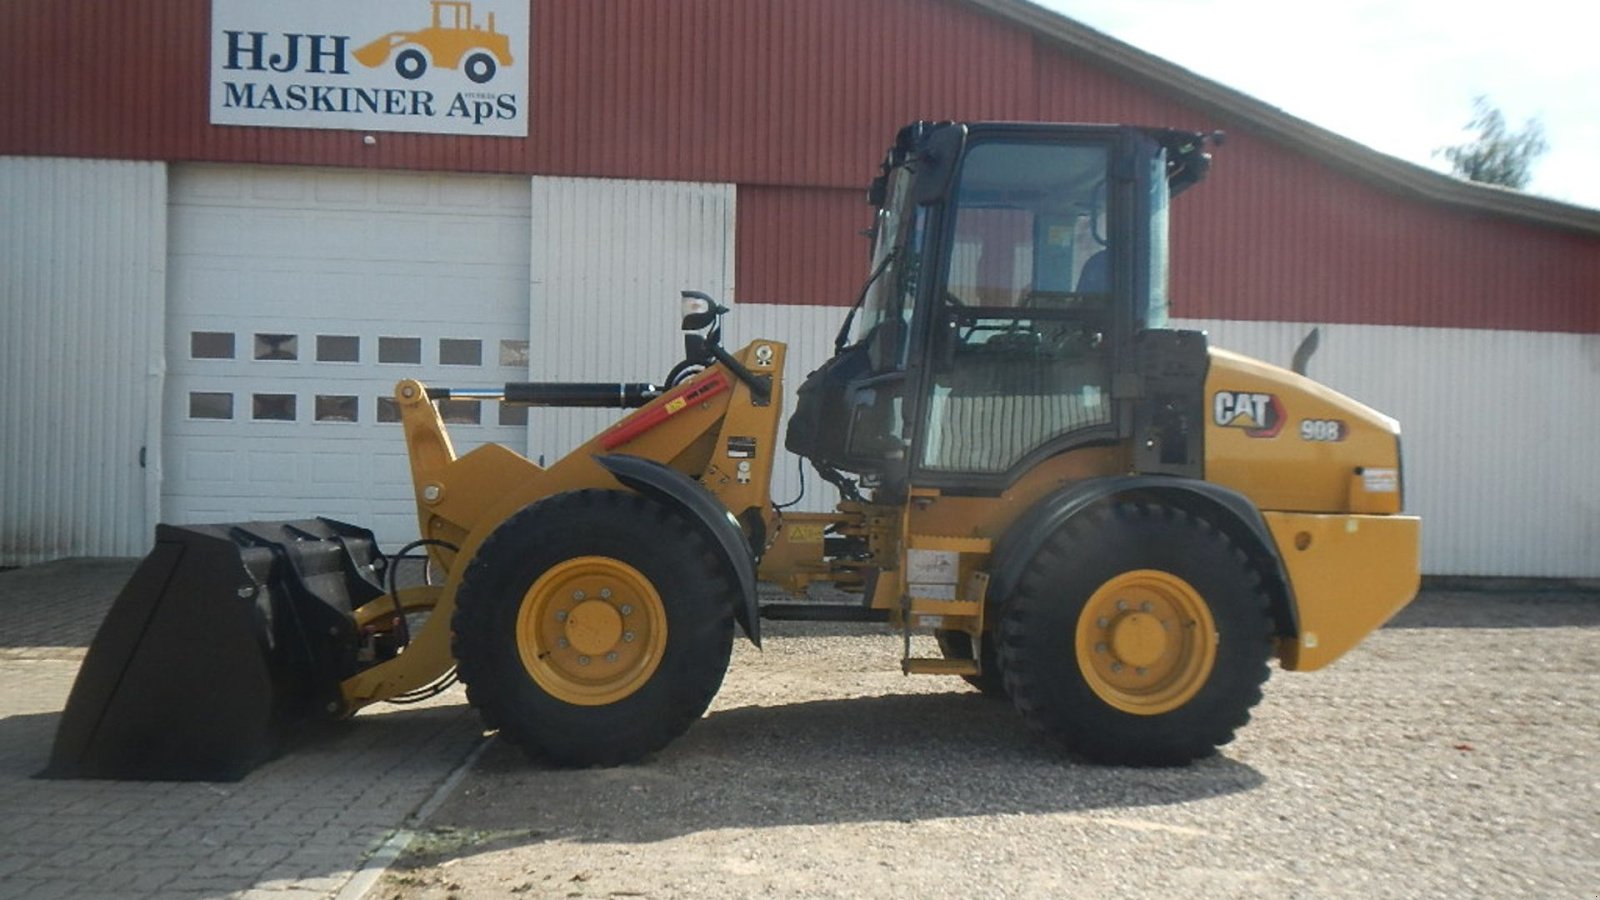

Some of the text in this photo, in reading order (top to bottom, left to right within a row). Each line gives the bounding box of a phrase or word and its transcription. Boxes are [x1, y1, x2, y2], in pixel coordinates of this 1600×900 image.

[222, 30, 350, 75] HJH
[223, 82, 517, 125] MASKINER ApS
[1215, 391, 1270, 428] CAT
[1301, 420, 1339, 440] 908
